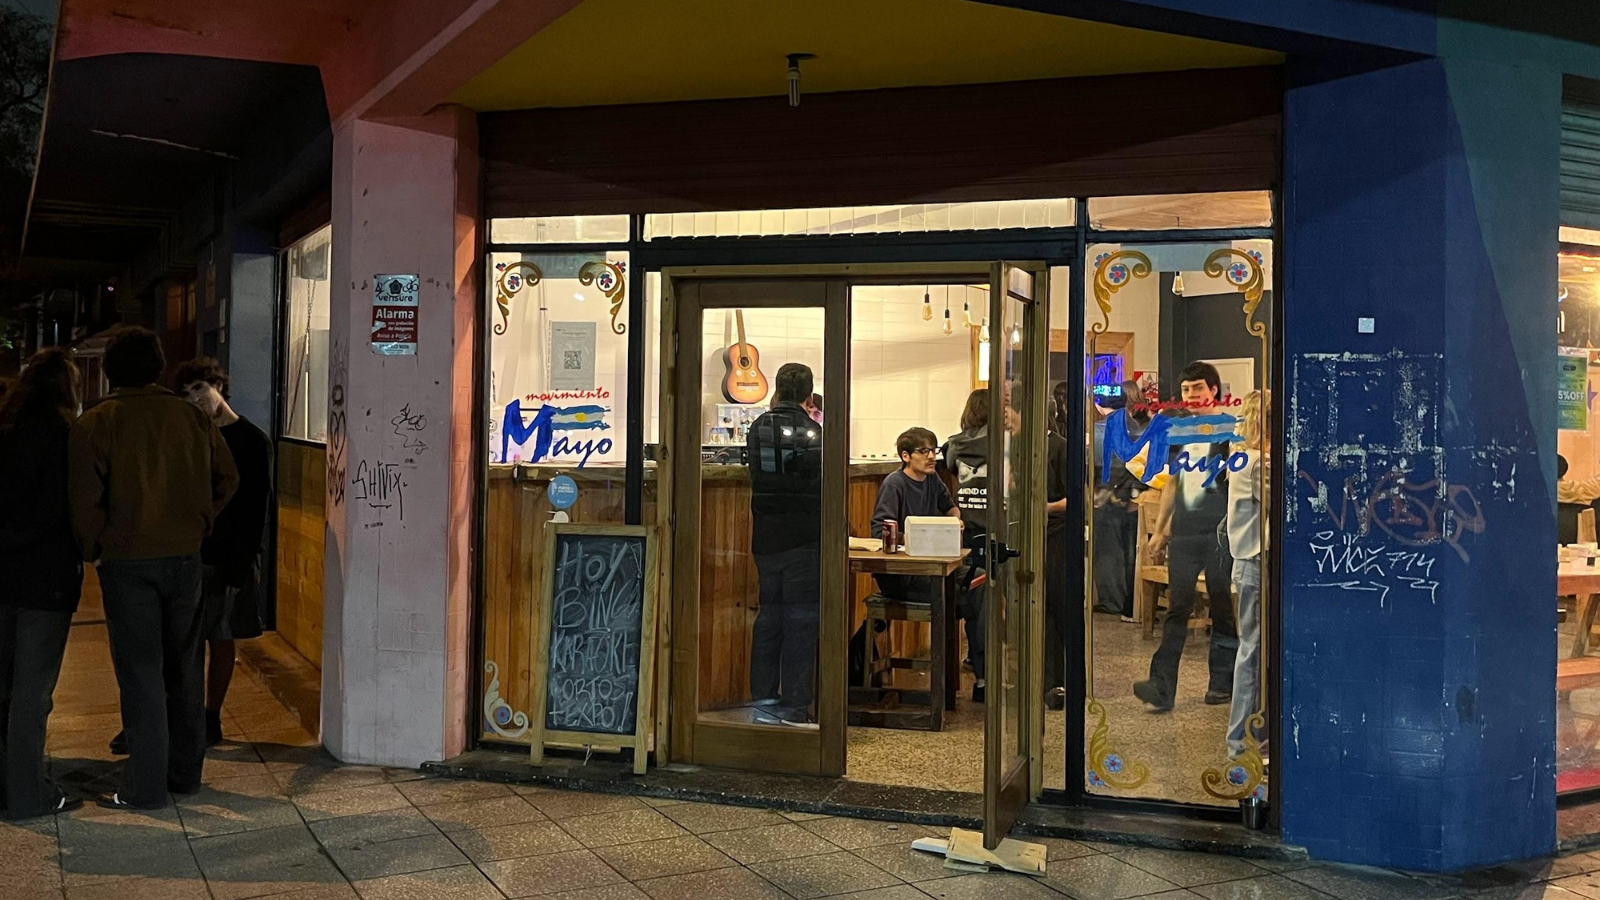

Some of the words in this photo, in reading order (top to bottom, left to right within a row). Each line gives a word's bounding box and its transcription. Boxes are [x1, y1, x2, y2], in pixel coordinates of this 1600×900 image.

[376, 308, 414, 319] Alarma
[525, 386, 610, 402] movimiento
[1132, 393, 1243, 412] movimiento
[500, 398, 613, 470] Mayo
[1102, 407, 1249, 488] Mayo
[552, 629, 636, 675] KARAOKE
